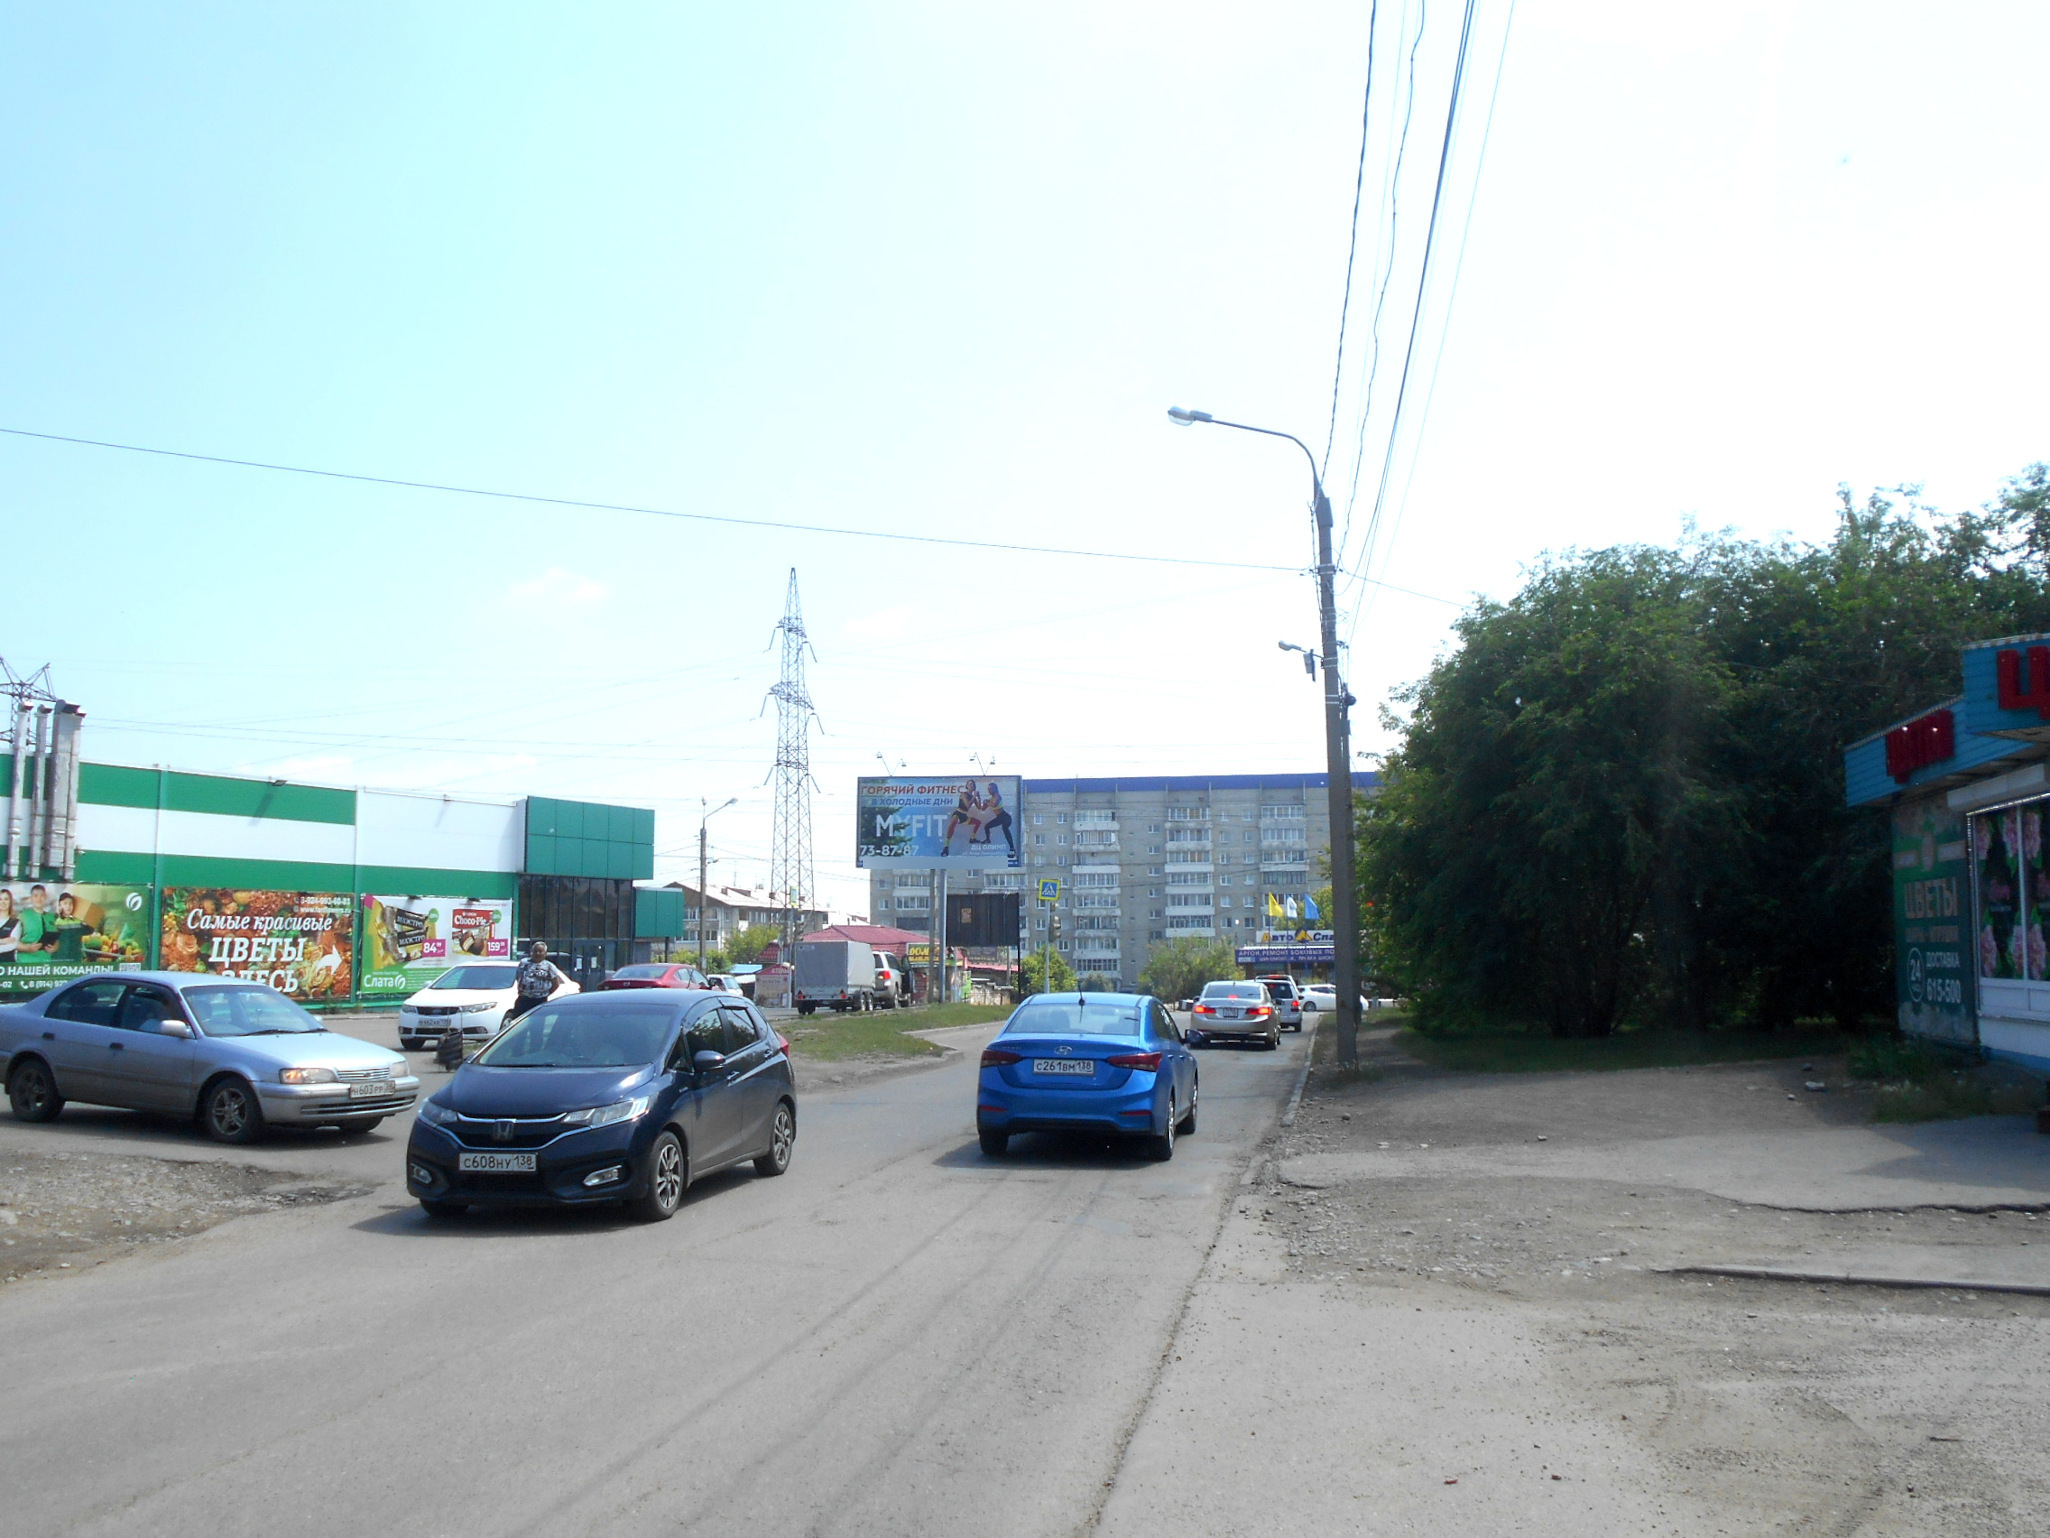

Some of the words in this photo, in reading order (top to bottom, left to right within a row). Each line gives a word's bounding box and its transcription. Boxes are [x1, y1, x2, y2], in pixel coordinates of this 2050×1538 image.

[861, 783, 914, 795] ГОРЯЧИЙ
[917, 785, 965, 795] ФИТНЕС
[880, 798, 931, 806] ХОЛОДНЫЕ
[933, 798, 953, 806] ДНИ
[860, 845, 919, 856] 73-87-87
[1904, 876, 1957, 918] ЦВЕТЫ
[187, 908, 250, 930] Самые
[254, 915, 332, 935] красивые
[1261, 932, 1293, 942] Авто
[208, 937, 307, 968] ЦВЕТЫ
[423, 942, 437, 953] 84
[488, 942, 500, 951] 159
[8, 964, 51, 976] НАШЕЙ
[53, 965, 114, 976] КОМАНДЫ!
[1911, 959, 1921, 981] 24
[364, 975, 393, 987] Слата
